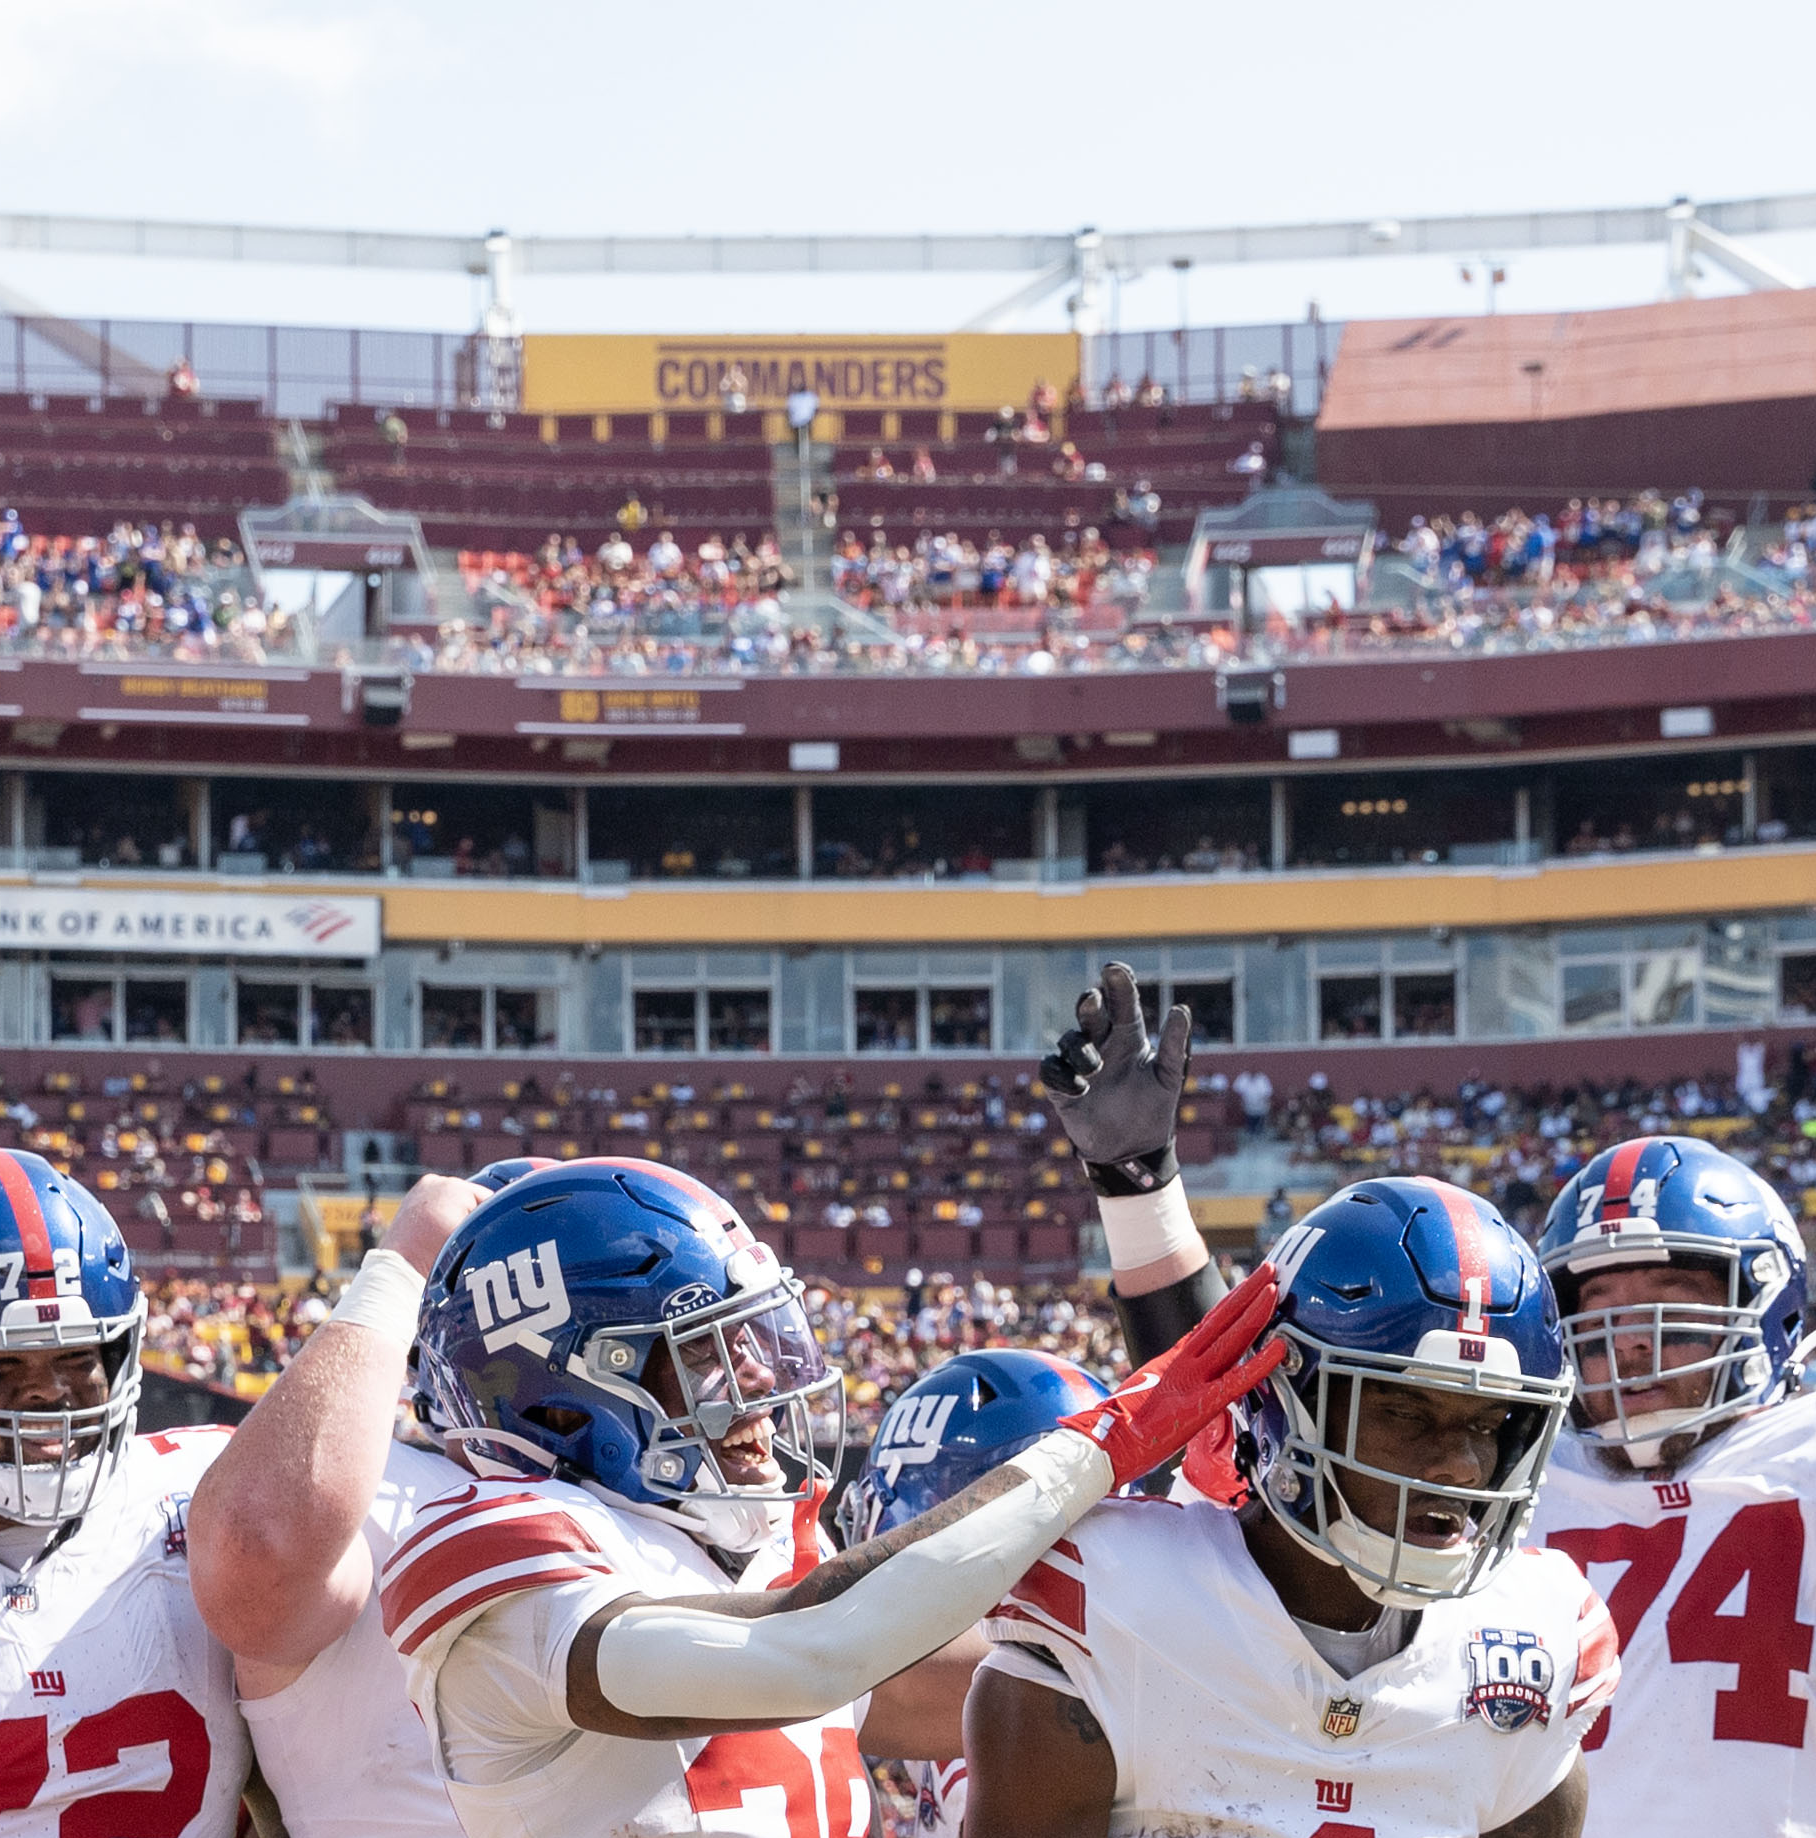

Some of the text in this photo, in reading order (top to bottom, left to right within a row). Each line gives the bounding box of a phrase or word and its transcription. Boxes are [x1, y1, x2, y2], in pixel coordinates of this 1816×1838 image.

[656, 356, 947, 401] COMMANDERS
[58, 910, 102, 937] OF
[114, 912, 275, 941] AMERICA
[664, 1294, 715, 1320] OAKLEY
[1462, 1276, 1486, 1332] 1
[1546, 1499, 1814, 1752] 74
[1469, 1642, 1554, 1694] 100
[1478, 1684, 1543, 1705] SEASONS
[1326, 1714, 1355, 1734] NFL
